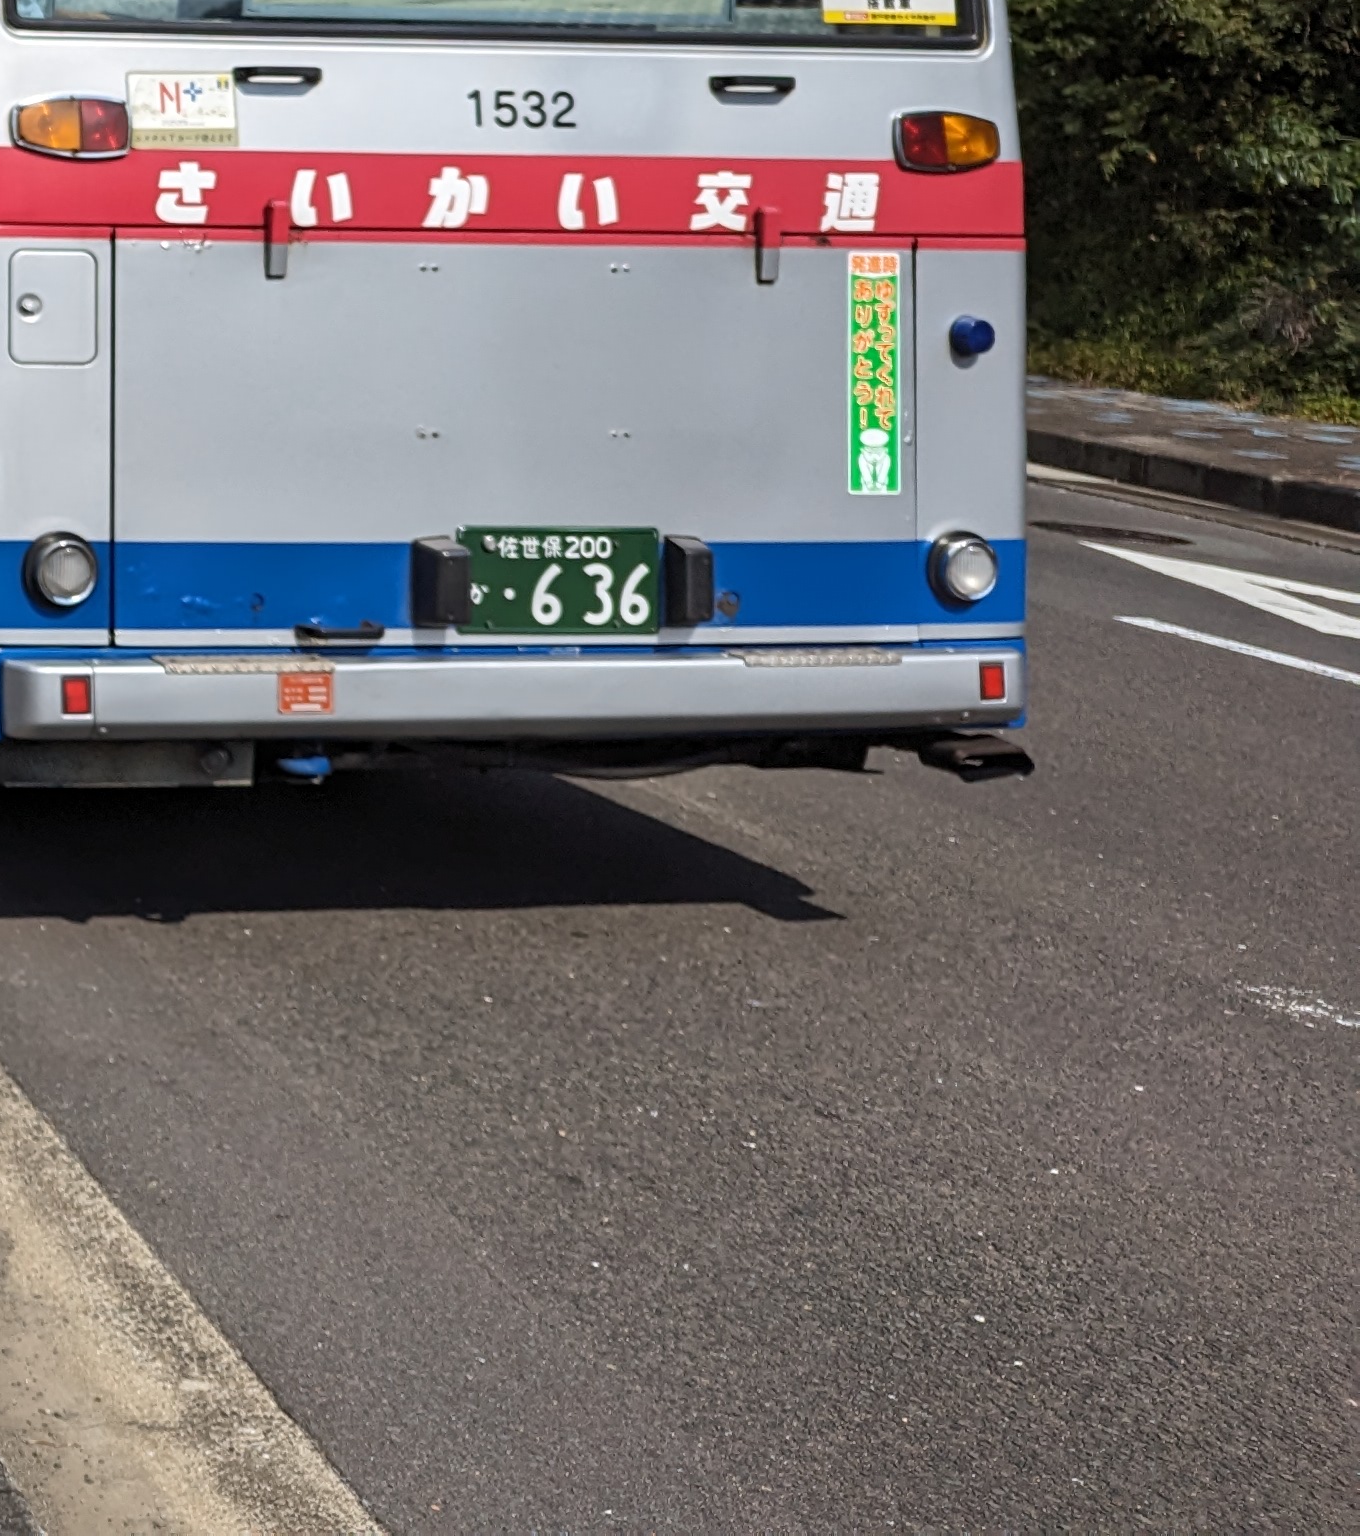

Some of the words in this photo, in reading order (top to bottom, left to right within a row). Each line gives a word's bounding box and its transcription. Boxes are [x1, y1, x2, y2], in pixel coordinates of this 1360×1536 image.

[467, 90, 577, 130] 1532
[155, 162, 880, 232] さいかい交通
[851, 255, 898, 274] 発進時
[875, 279, 896, 431] ゆずってくれて
